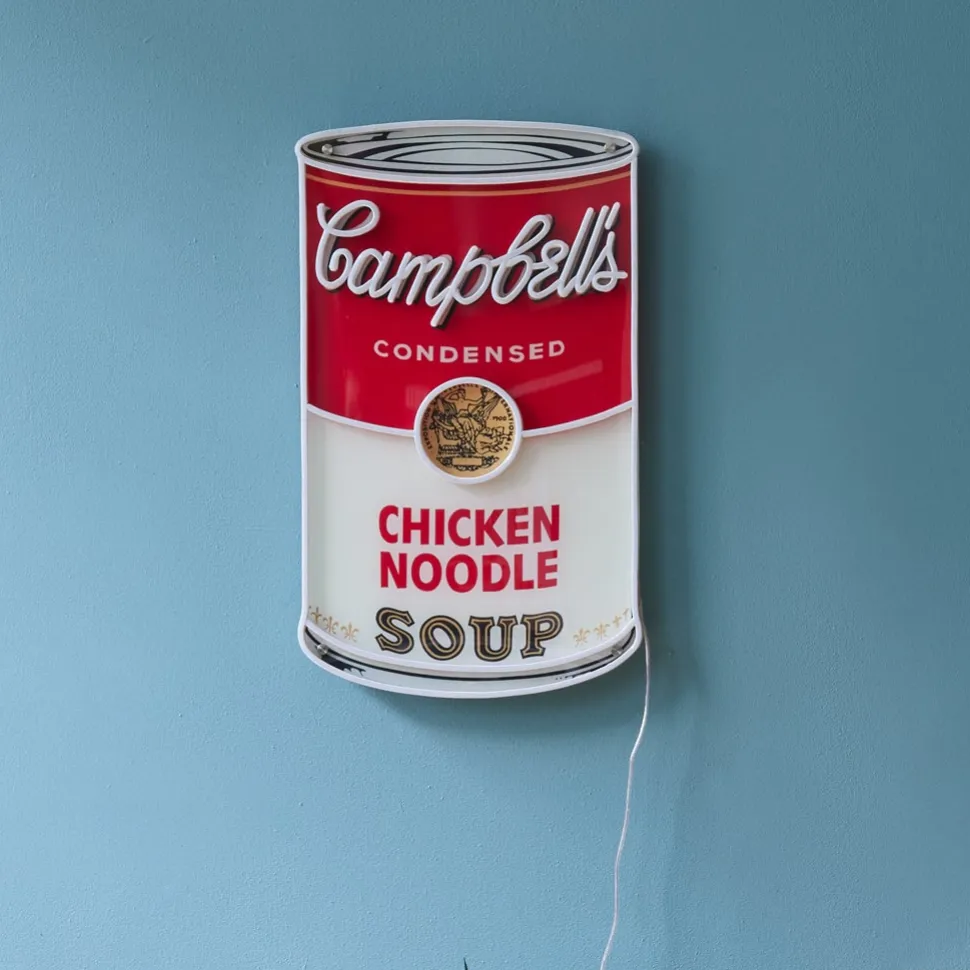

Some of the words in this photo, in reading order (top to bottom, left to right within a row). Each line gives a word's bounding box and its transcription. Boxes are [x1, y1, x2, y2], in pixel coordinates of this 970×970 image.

[315, 199, 628, 328] Campbell's
[373, 339, 566, 364] CONDENSED
[378, 504, 561, 548] CHICKEN
[379, 549, 559, 594] NOODLE
[375, 606, 564, 663] SOUP
